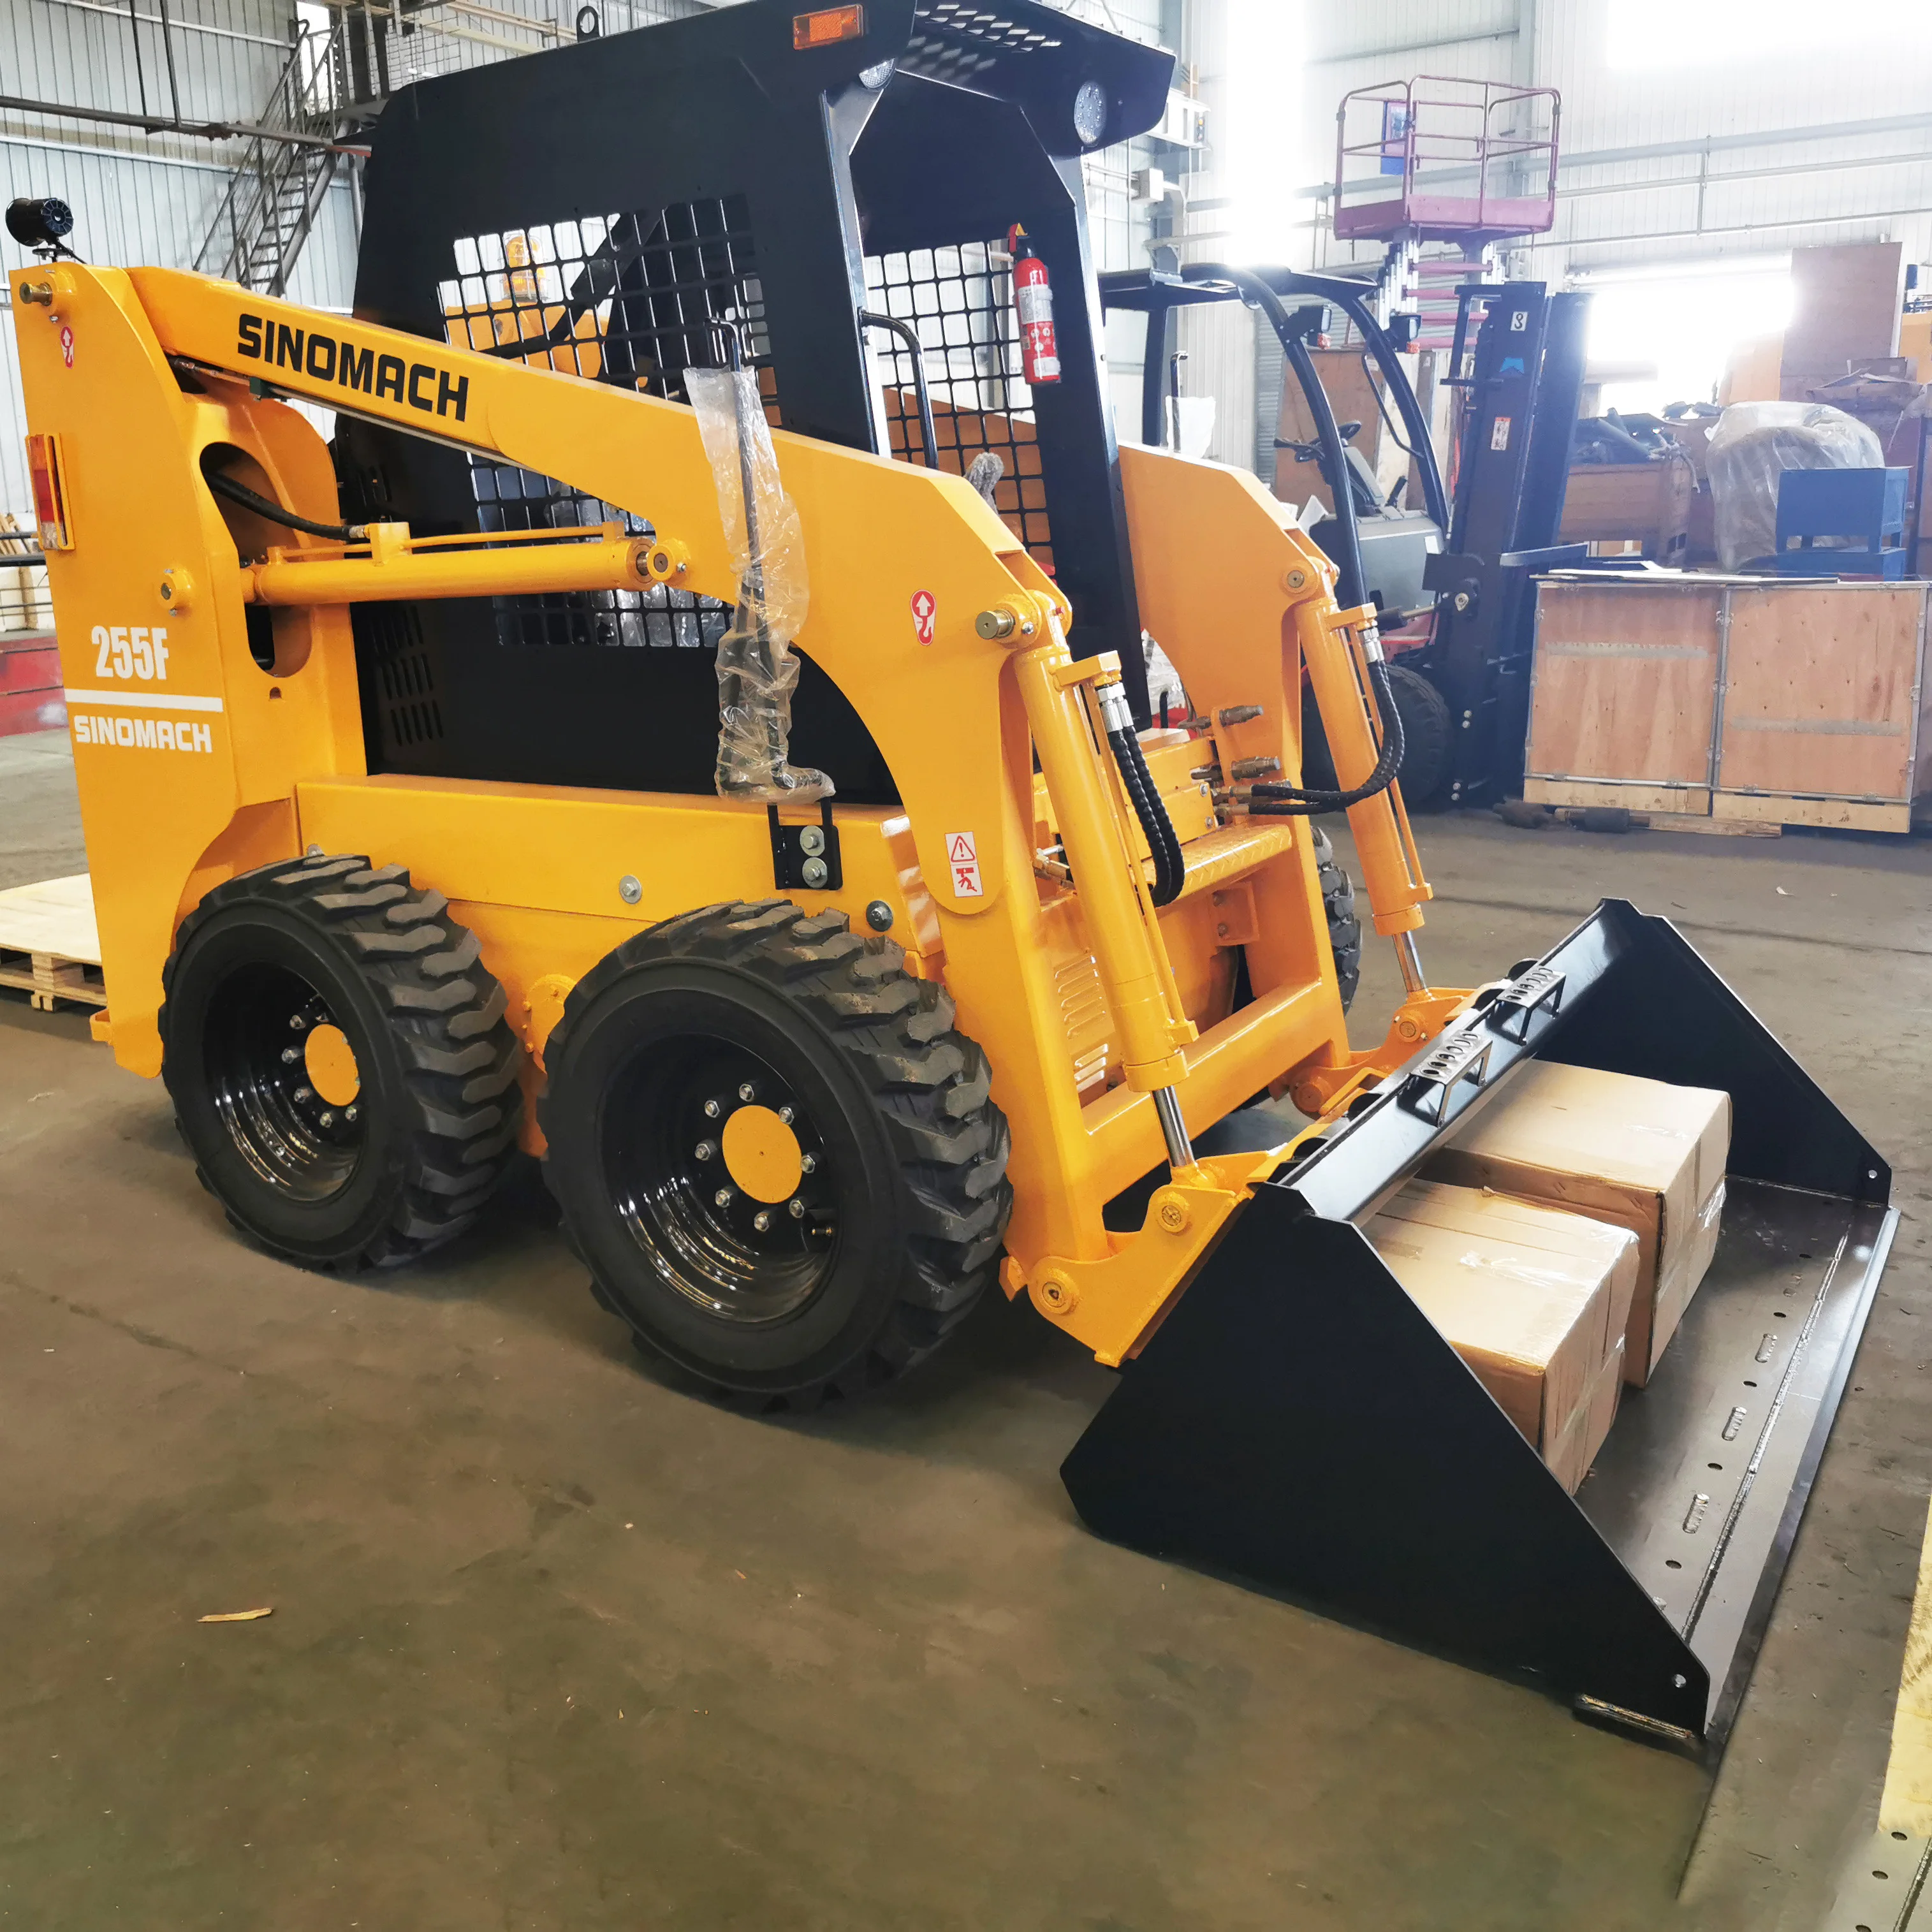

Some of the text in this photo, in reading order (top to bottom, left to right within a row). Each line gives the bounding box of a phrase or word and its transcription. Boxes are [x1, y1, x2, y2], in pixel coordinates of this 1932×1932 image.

[238, 313, 469, 422] SINOMACH
[91, 625, 169, 680] 255F
[74, 715, 213, 753] SINOMACH
